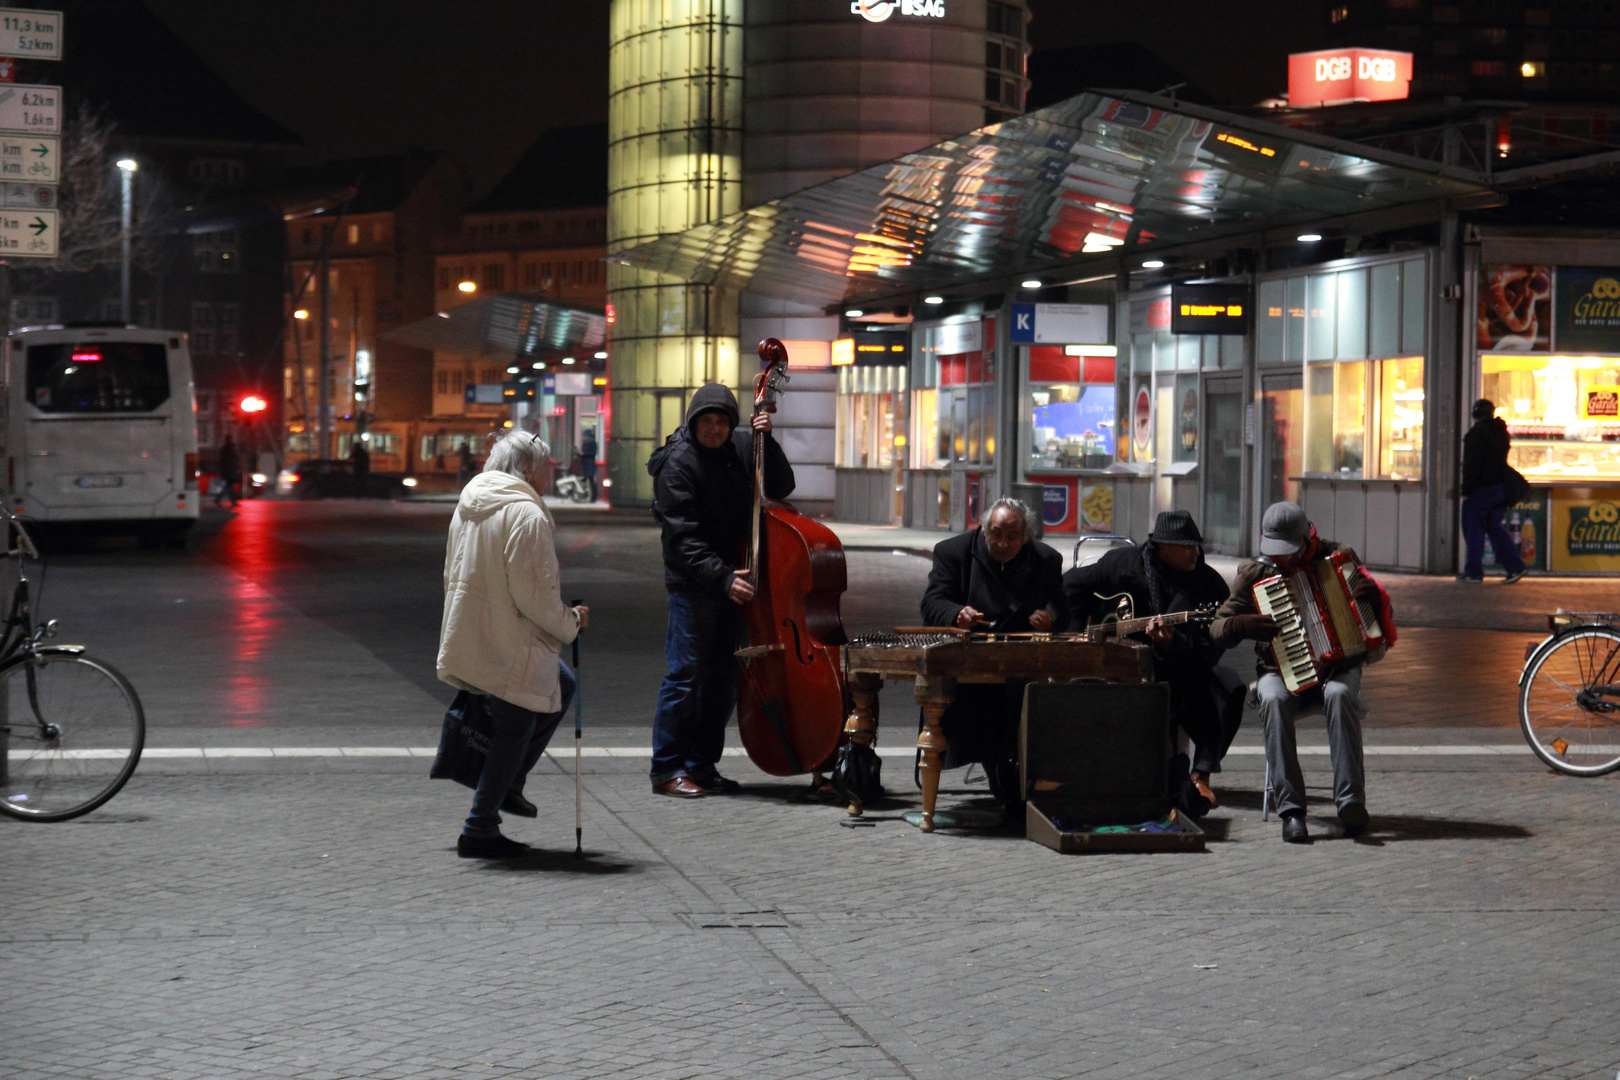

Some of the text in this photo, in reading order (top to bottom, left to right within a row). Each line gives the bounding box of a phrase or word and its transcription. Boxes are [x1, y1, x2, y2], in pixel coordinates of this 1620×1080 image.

[4, 17, 54, 33] 11,3 km
[1315, 57, 1351, 82] DGB
[1358, 57, 1396, 82] DGB
[1017, 313, 1030, 330] K
